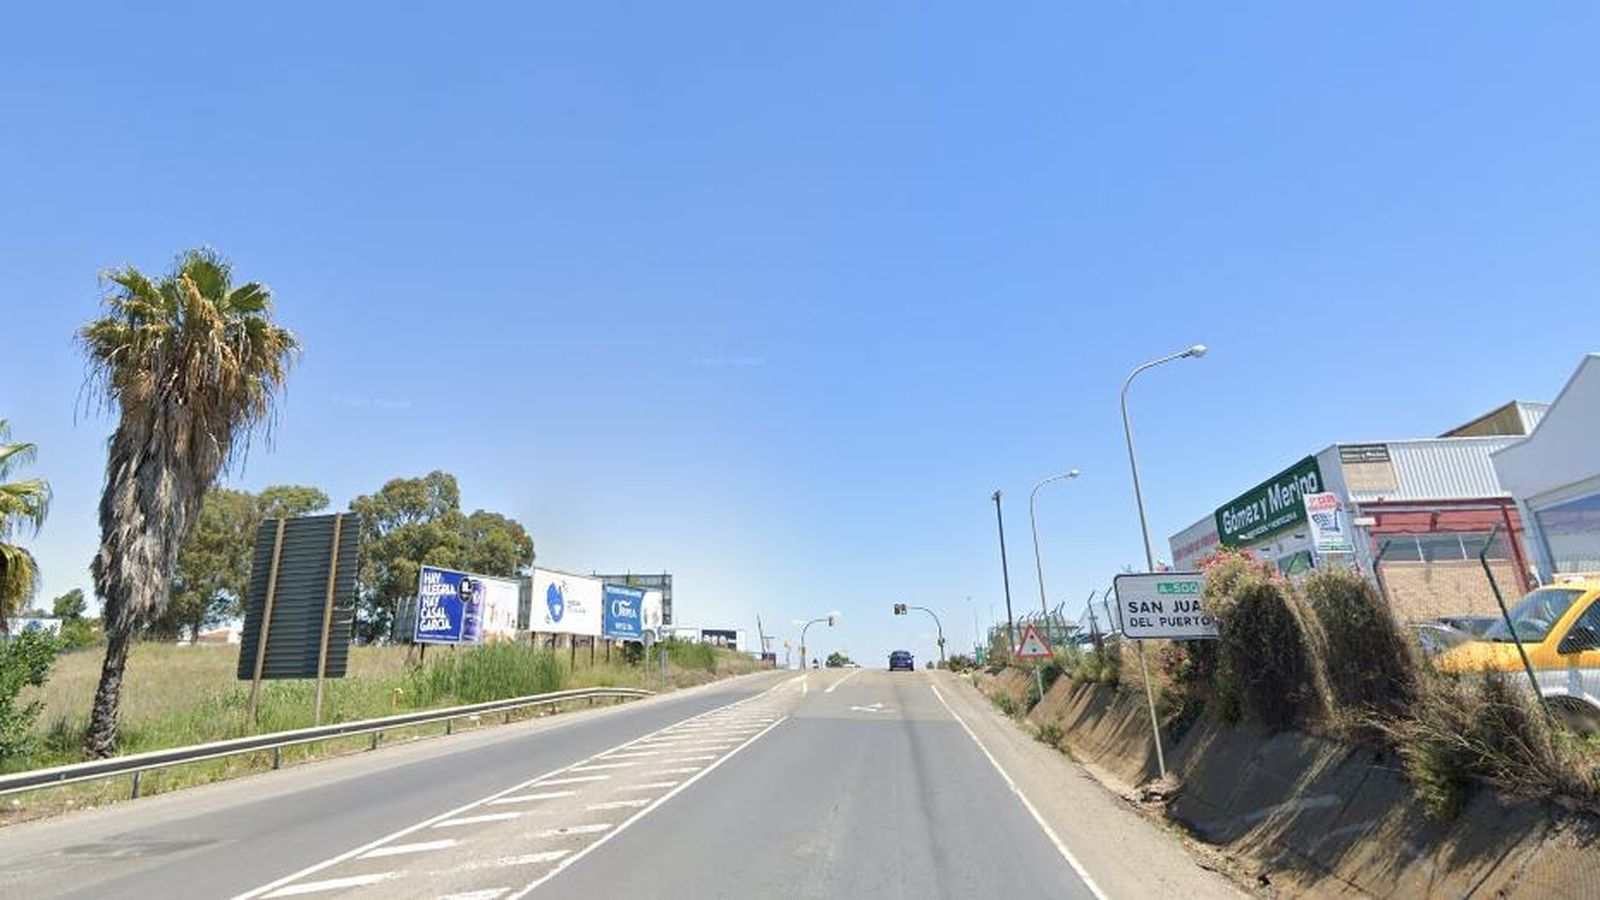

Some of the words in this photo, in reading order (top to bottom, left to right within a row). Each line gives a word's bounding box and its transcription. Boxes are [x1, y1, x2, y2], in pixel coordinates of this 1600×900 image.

[1223, 502, 1260, 535] Gómez
[1260, 497, 1268, 521] y
[1267, 471, 1318, 513] Merino
[424, 572, 442, 584] HAY
[420, 606, 447, 619] CASAL
[1128, 601, 1163, 613] SAN
[1173, 600, 1201, 613] JUA
[1130, 617, 1153, 627] DEL
[1160, 616, 1211, 628] PUERTO
